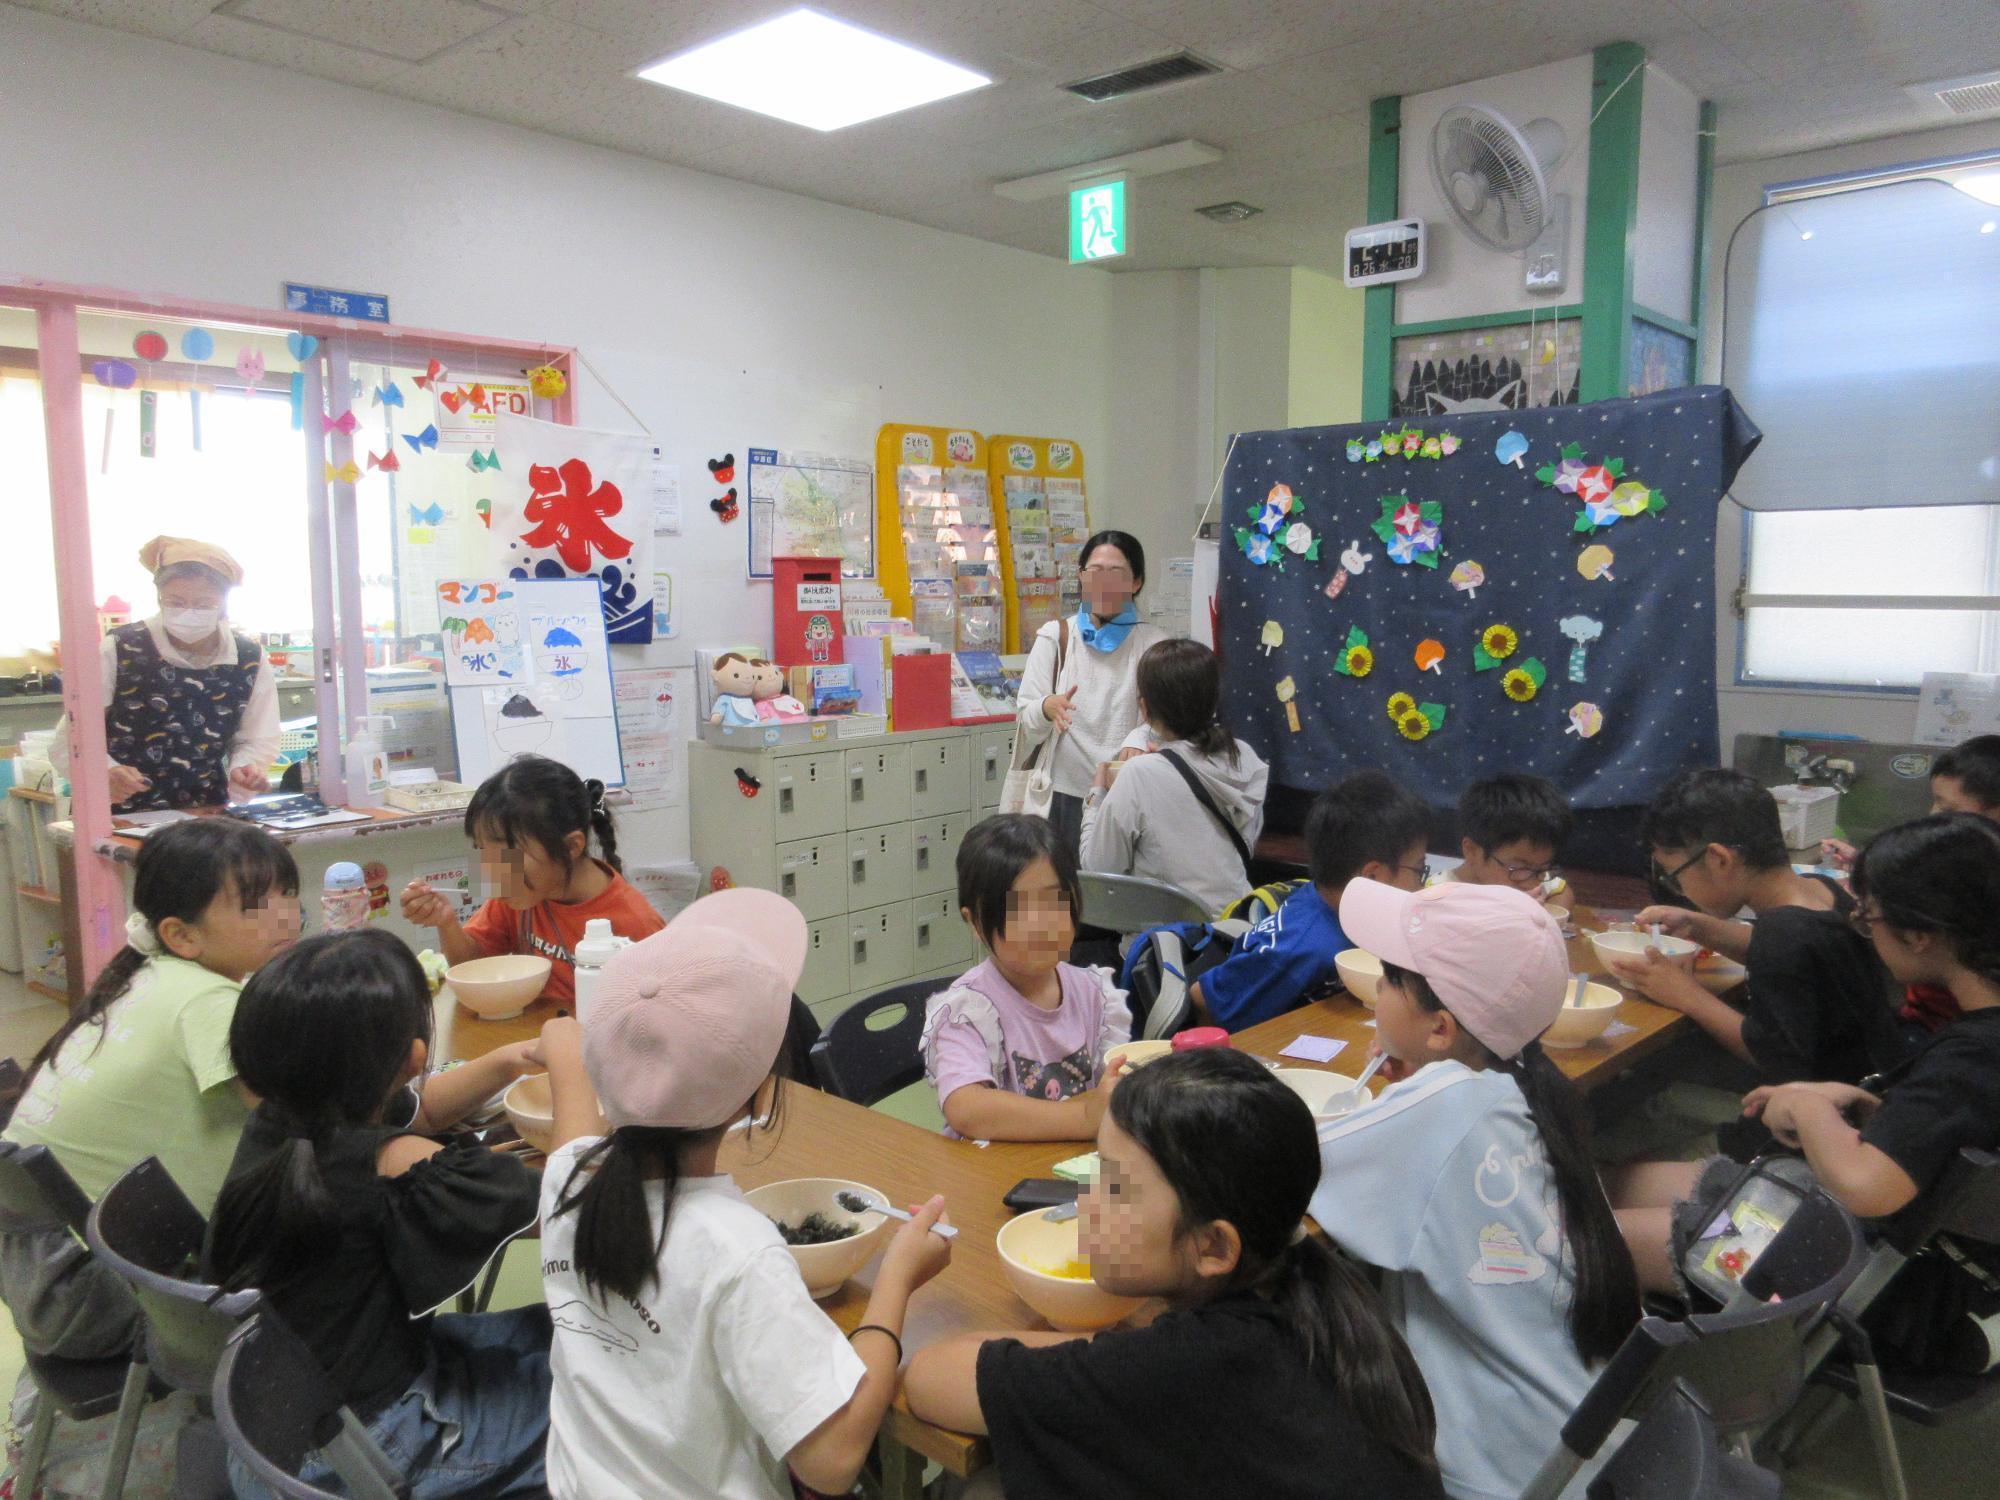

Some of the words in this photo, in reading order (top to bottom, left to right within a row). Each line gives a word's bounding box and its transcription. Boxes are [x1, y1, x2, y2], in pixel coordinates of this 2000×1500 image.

[520, 458, 634, 572] 氷
[438, 581, 515, 604] マンゴー
